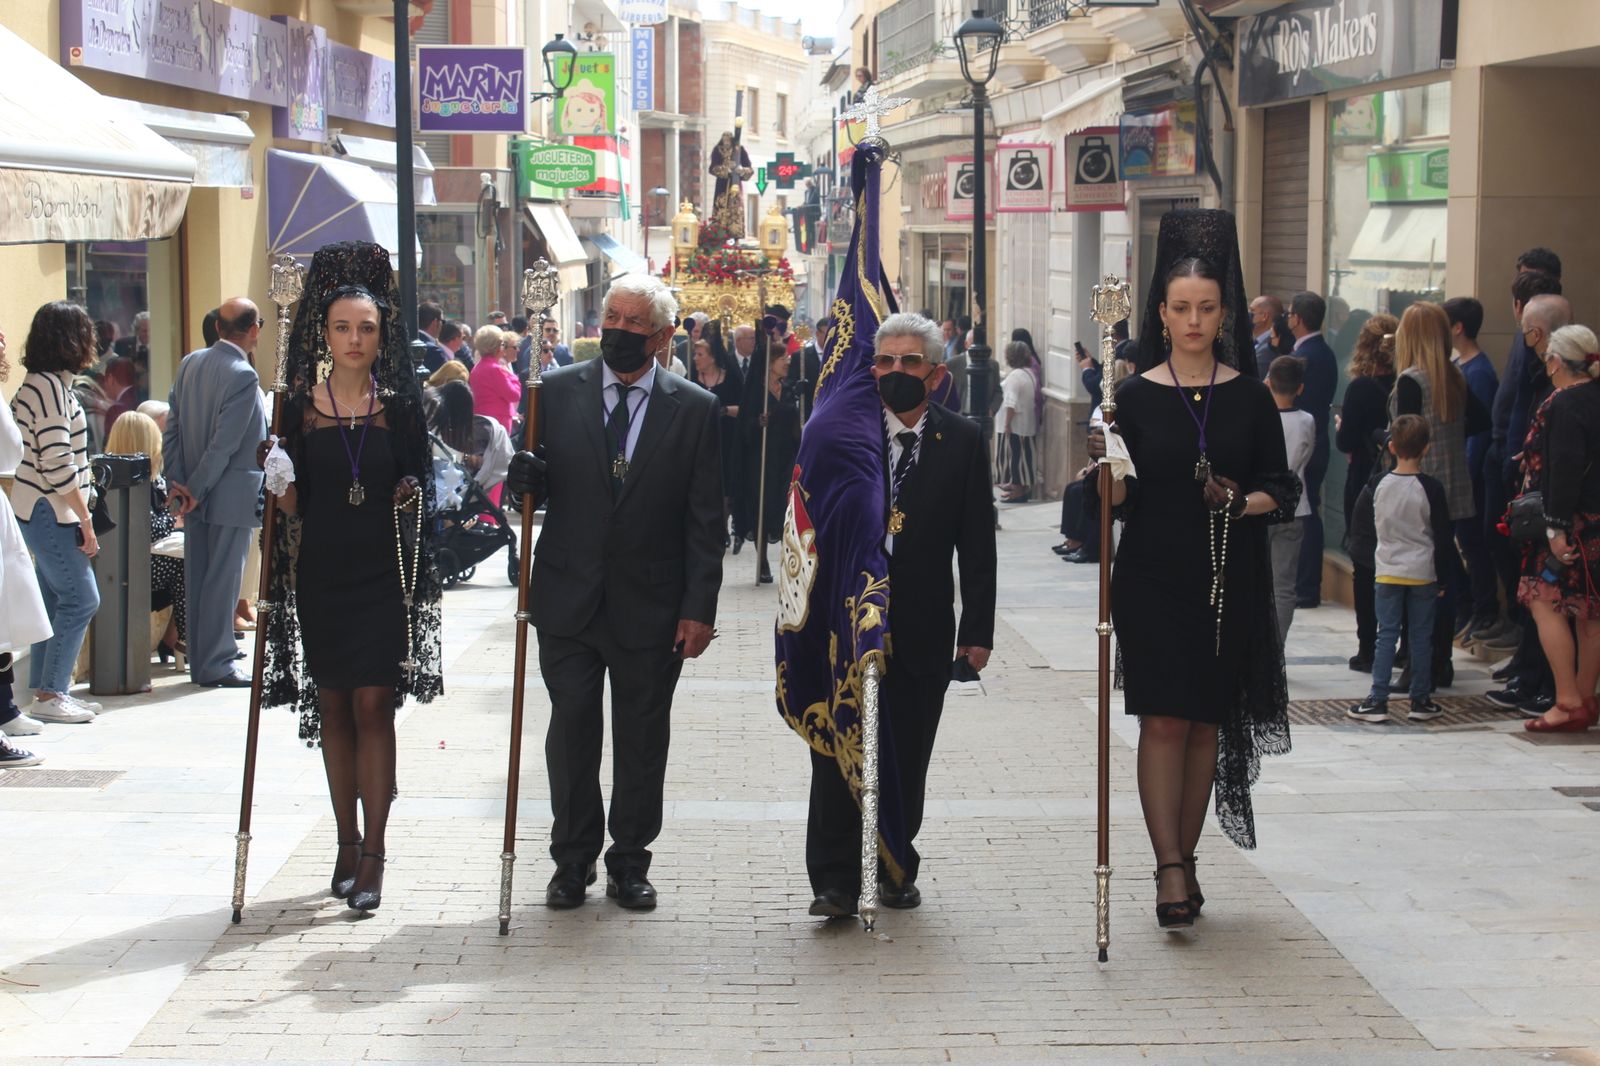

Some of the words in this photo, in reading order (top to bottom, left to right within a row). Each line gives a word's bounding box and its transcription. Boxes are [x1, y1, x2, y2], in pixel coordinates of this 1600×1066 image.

[1313, 0, 1377, 68] Makers
[635, 29, 650, 109] MAJUELOS
[536, 166, 589, 183] majuelos
